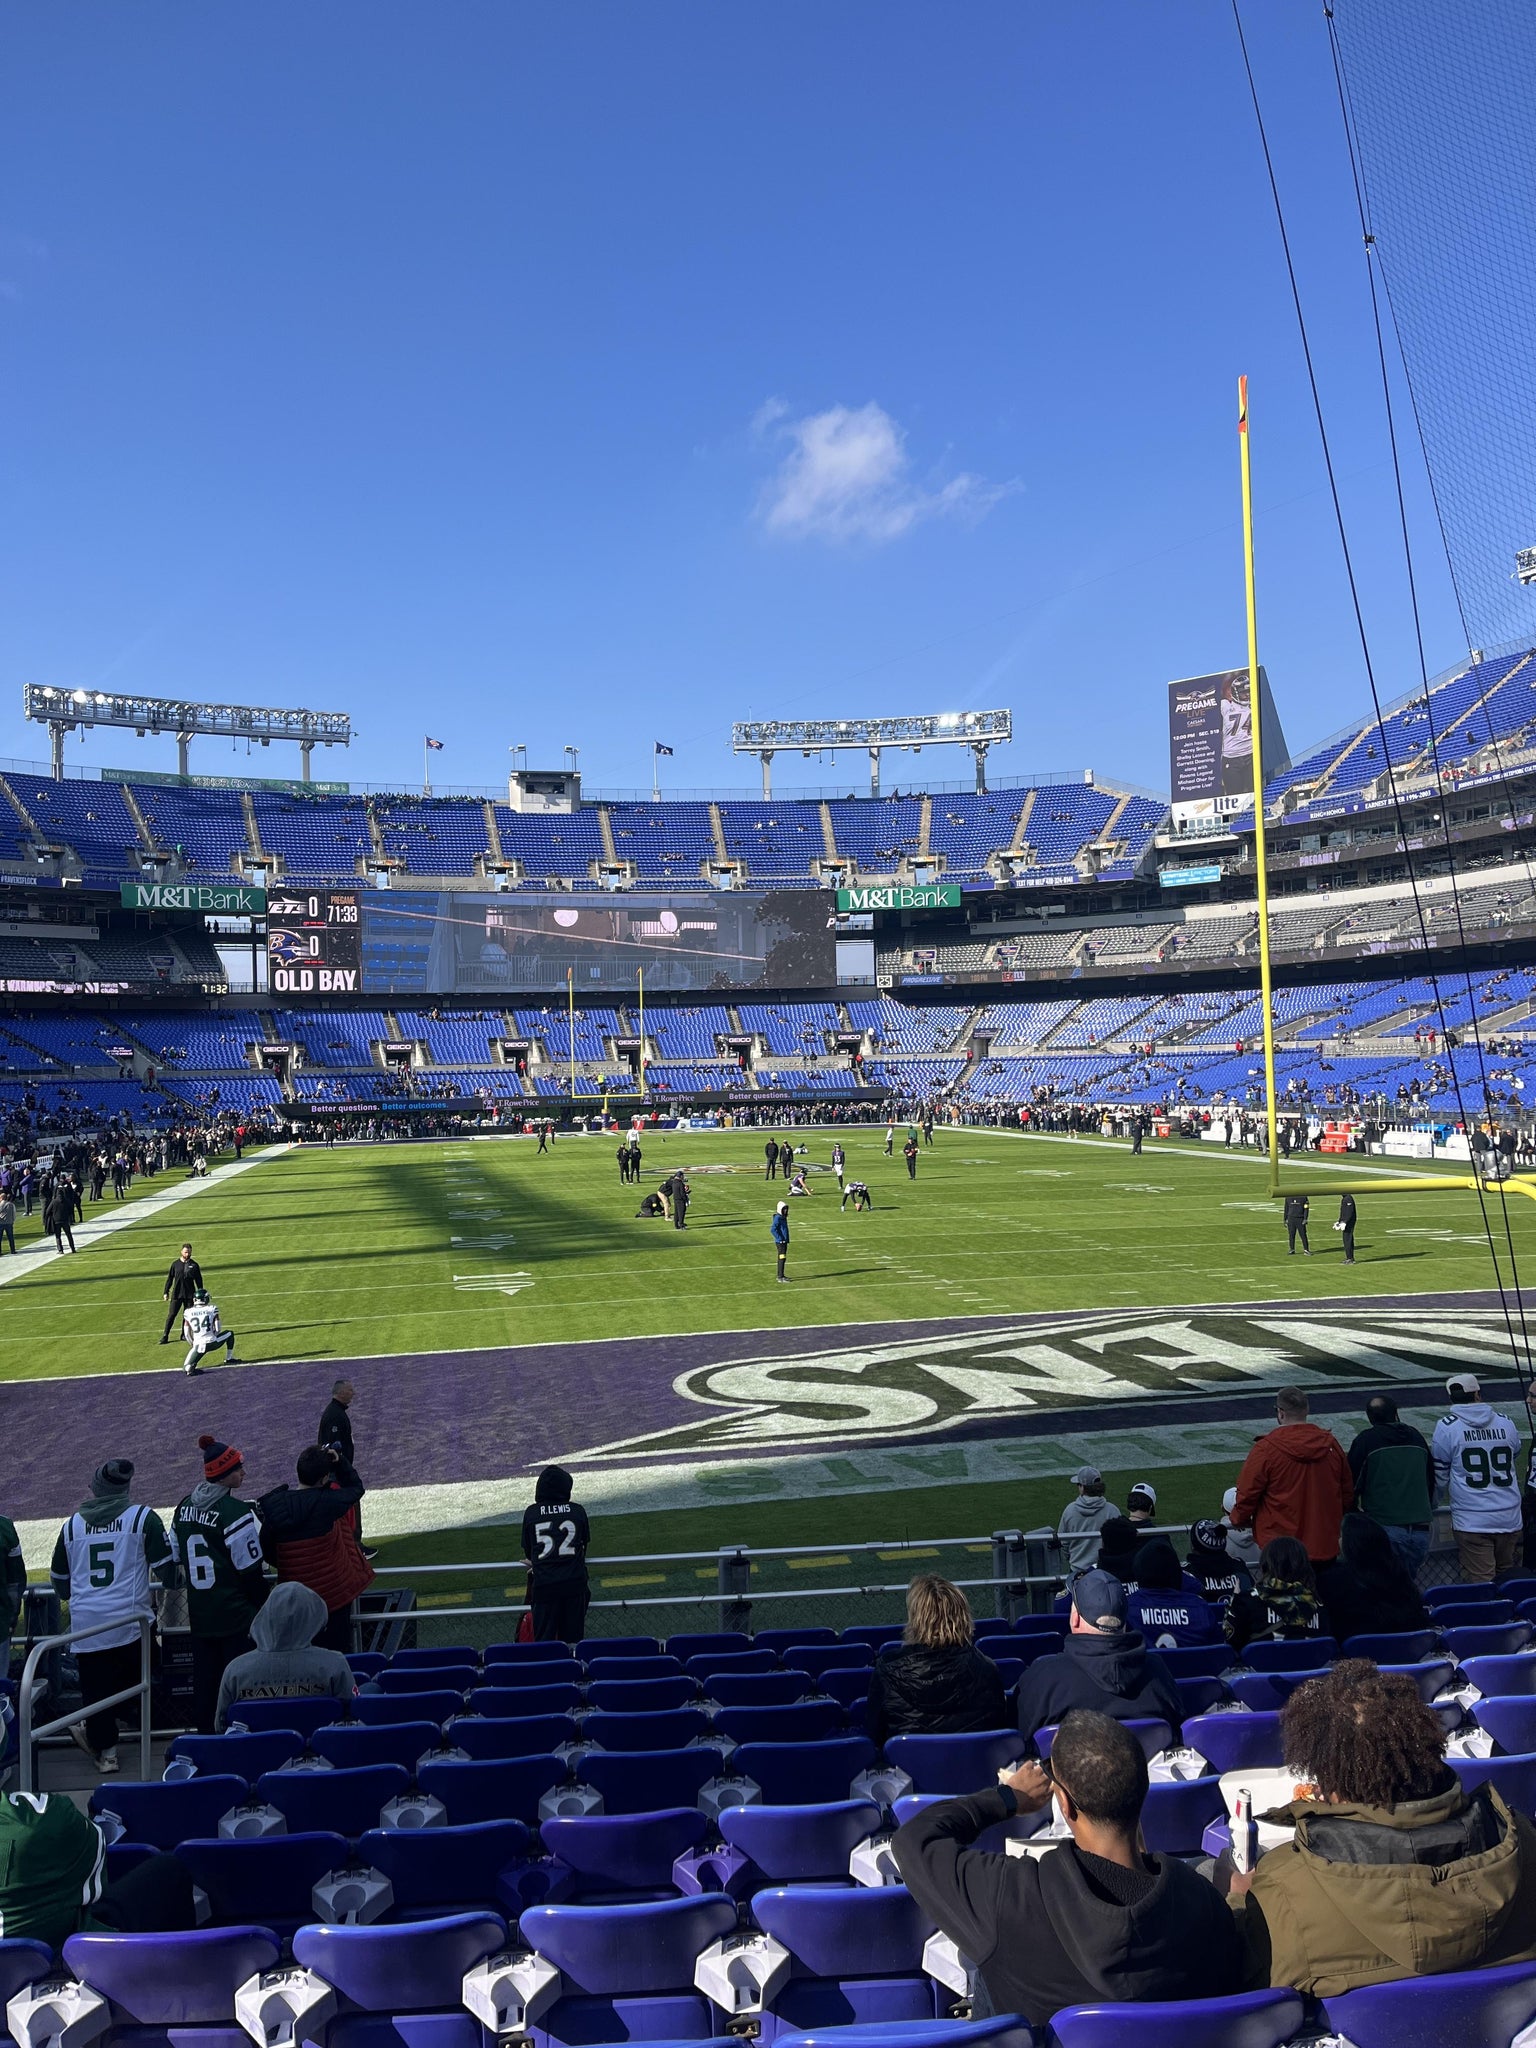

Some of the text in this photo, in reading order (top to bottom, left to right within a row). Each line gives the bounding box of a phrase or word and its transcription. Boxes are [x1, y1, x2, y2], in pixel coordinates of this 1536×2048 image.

[1175, 698, 1217, 712] PREGAME
[1187, 710, 1206, 718] LIVE
[192, 777, 261, 788] HONOR ROWS
[1213, 797, 1239, 813] Lite
[1365, 800, 1387, 809] EARNEST
[135, 885, 252, 910] M&T Bank
[330, 896, 355, 904] PREGAME
[848, 887, 949, 909] M&T Bank
[308, 896, 318, 917] 0
[327, 905, 358, 922] 71:33
[310, 936, 319, 956] 0
[7, 980, 54, 992] WARMUPS
[275, 969, 358, 991] OLD BAY.
[879, 977, 890, 986] 25
[753, 1092, 791, 1101] questions.
[338, 1104, 380, 1113] questions.
[190, 1316, 210, 1333] 34
[1464, 1429, 1506, 1442] MCDONALD
[1461, 1446, 1513, 1489] 99
[540, 1504, 571, 1515] R.LEWIS
[535, 1520, 576, 1559] 52
[247, 1540, 258, 1559] 6
[89, 1542, 114, 1588] 5
[187, 1534, 216, 1590] 6
[1205, 1575, 1239, 1591] JACKSO
[1141, 1608, 1189, 1626] WIGGINS
[240, 1684, 326, 1698] RAVENS
